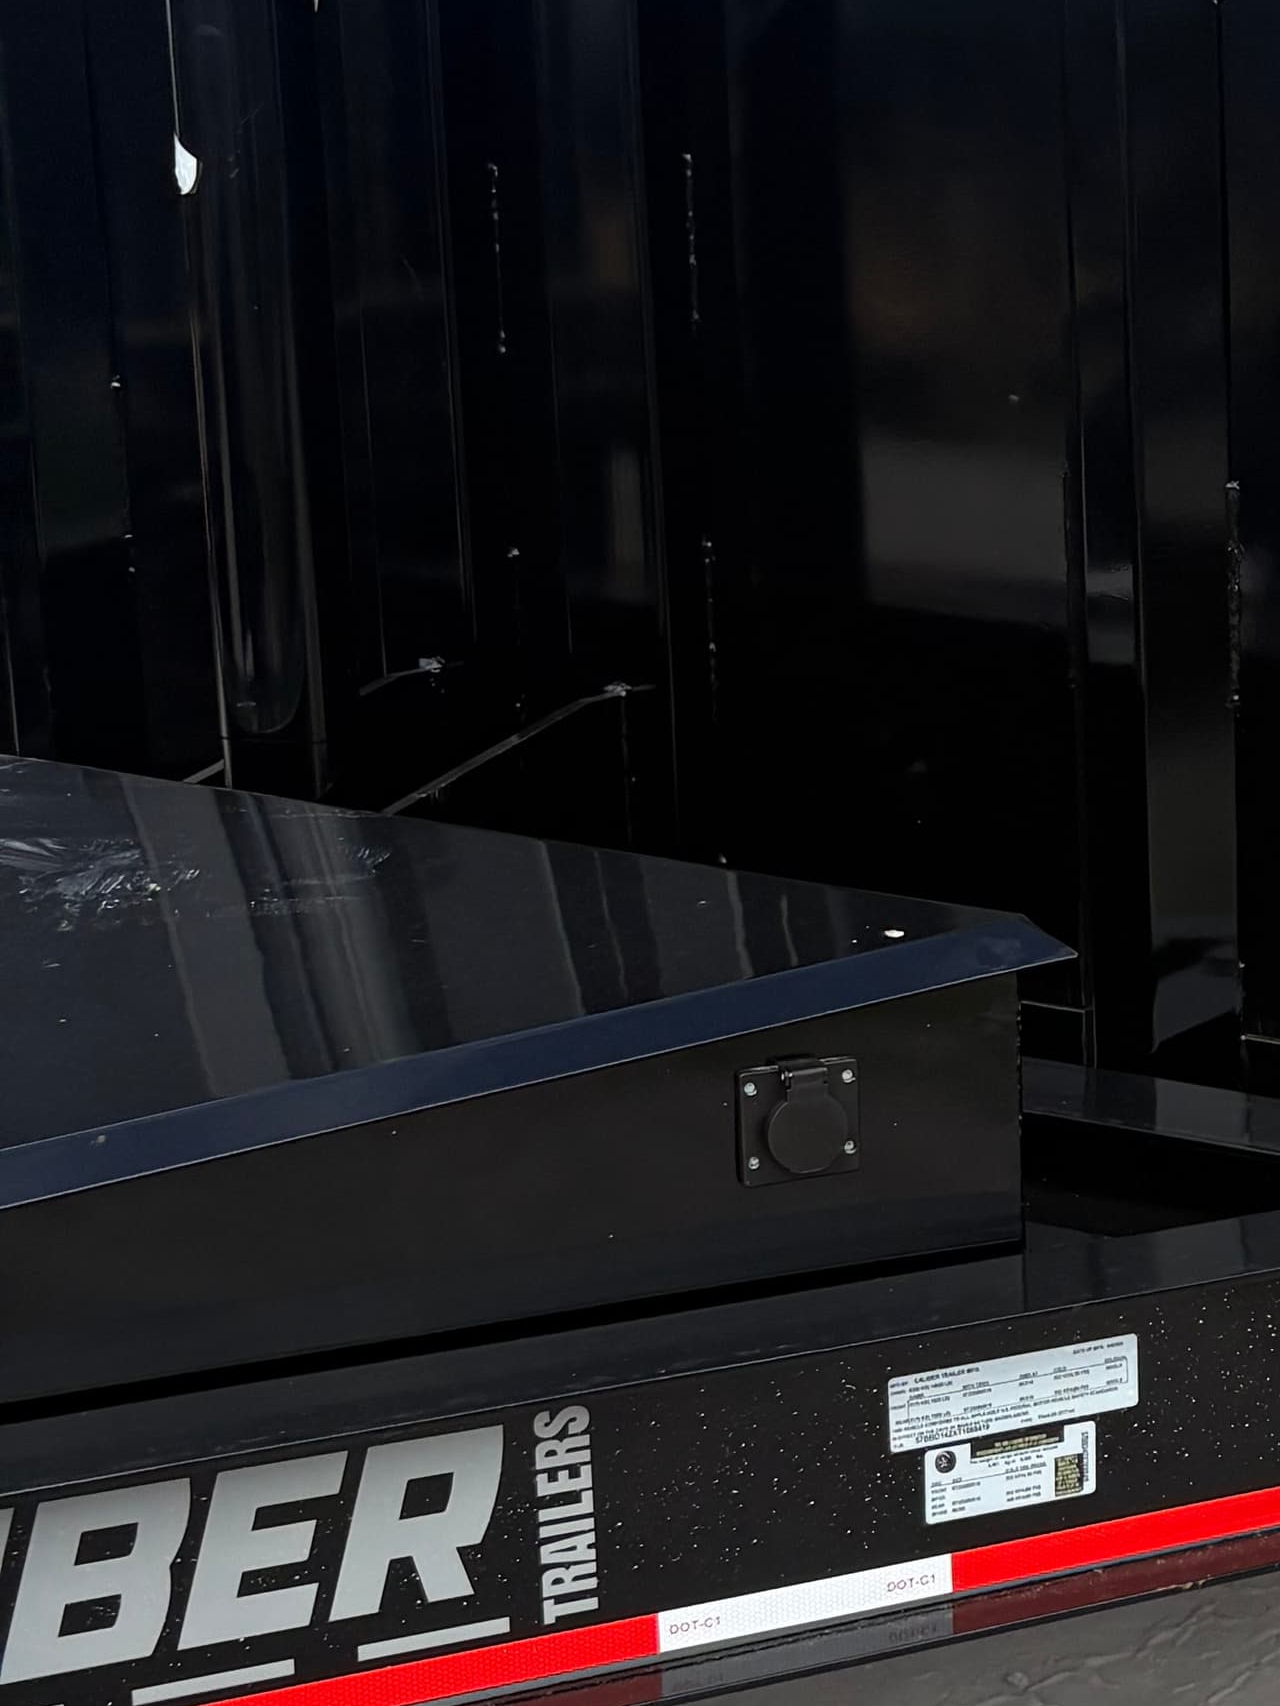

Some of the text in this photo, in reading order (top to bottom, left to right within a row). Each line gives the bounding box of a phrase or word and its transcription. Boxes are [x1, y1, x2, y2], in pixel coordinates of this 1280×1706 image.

[0, 1424, 504, 1686] BER
[532, 1403, 600, 1626] TRAILERS
[668, 1616, 722, 1636] DOT-C1
[886, 1573, 937, 1593] DOT-C1
